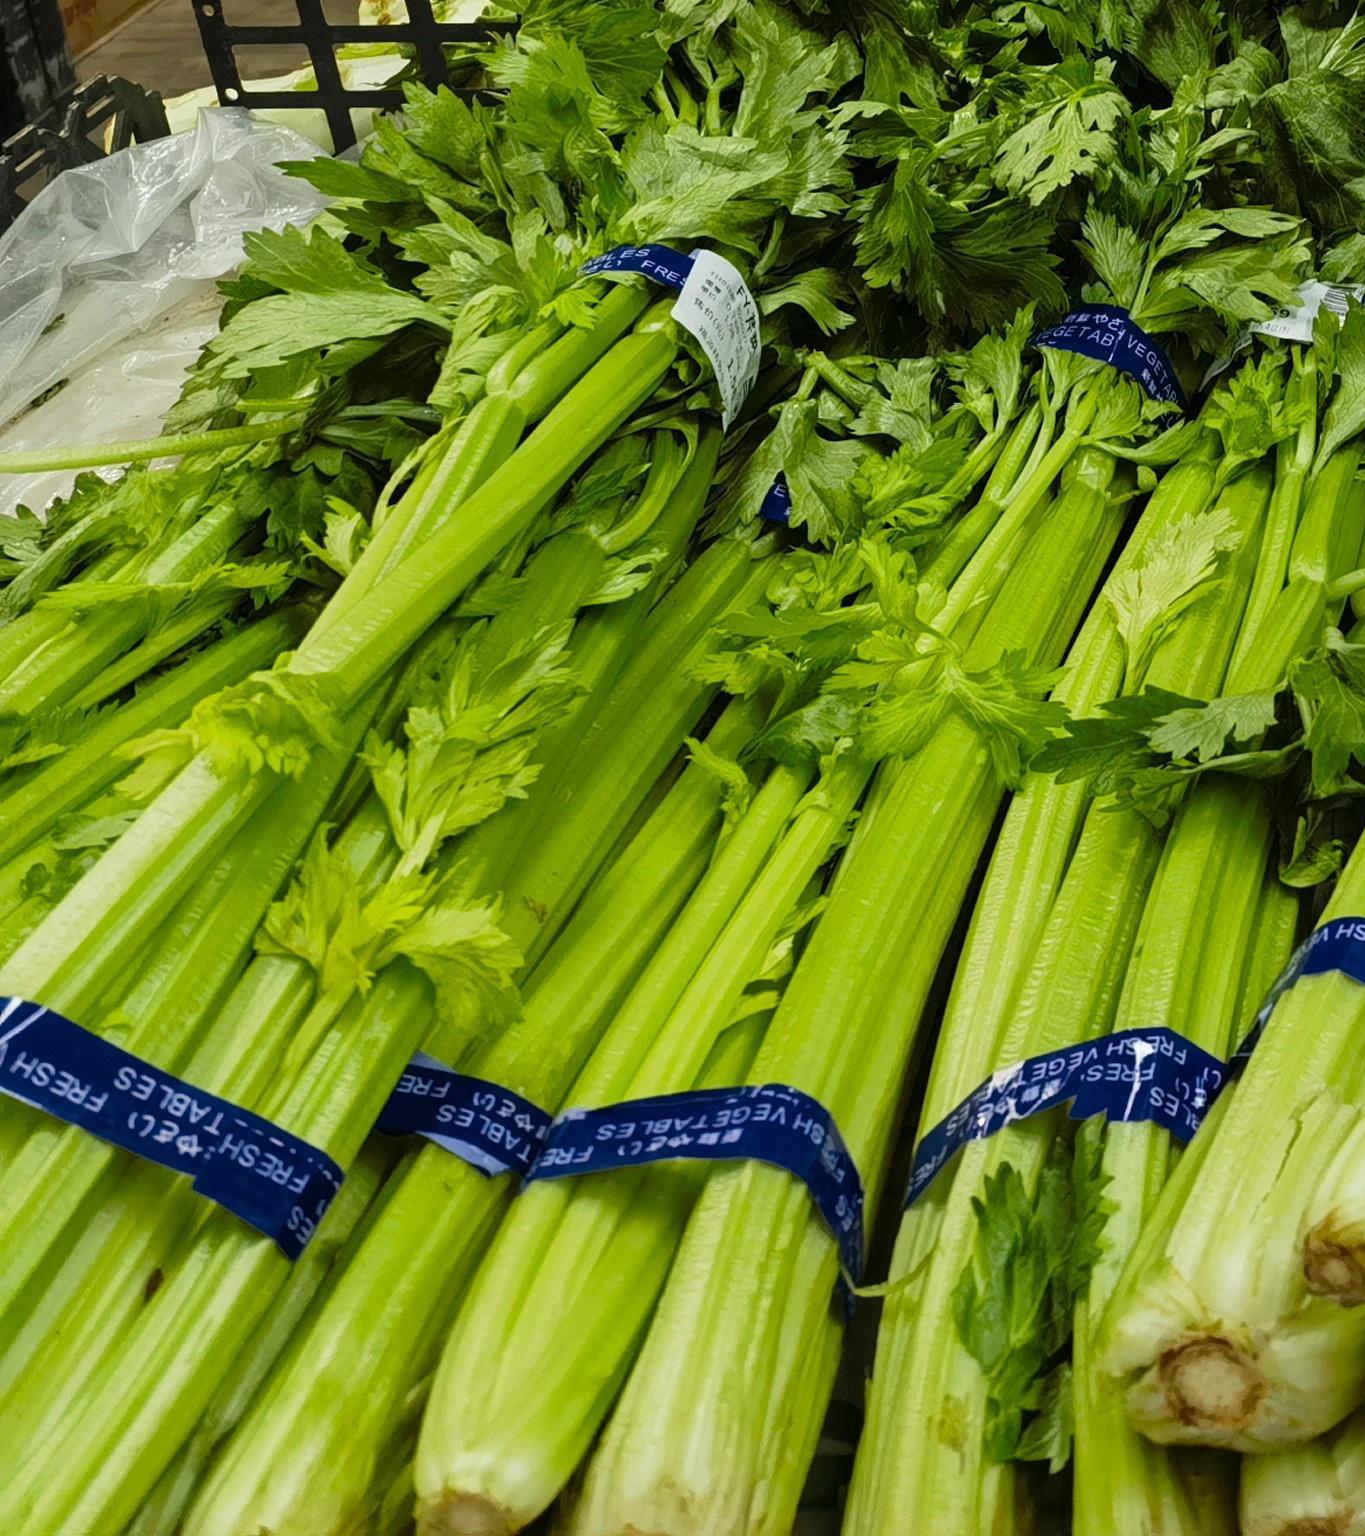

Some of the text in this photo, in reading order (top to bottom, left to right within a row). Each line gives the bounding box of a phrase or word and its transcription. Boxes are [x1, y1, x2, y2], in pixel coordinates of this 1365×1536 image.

[9, 1051, 109, 1113] FRESH
[436, 1103, 532, 1164] TABLES
[595, 1100, 787, 1143] VEGETABLES
[217, 1133, 312, 1194] FRESH
